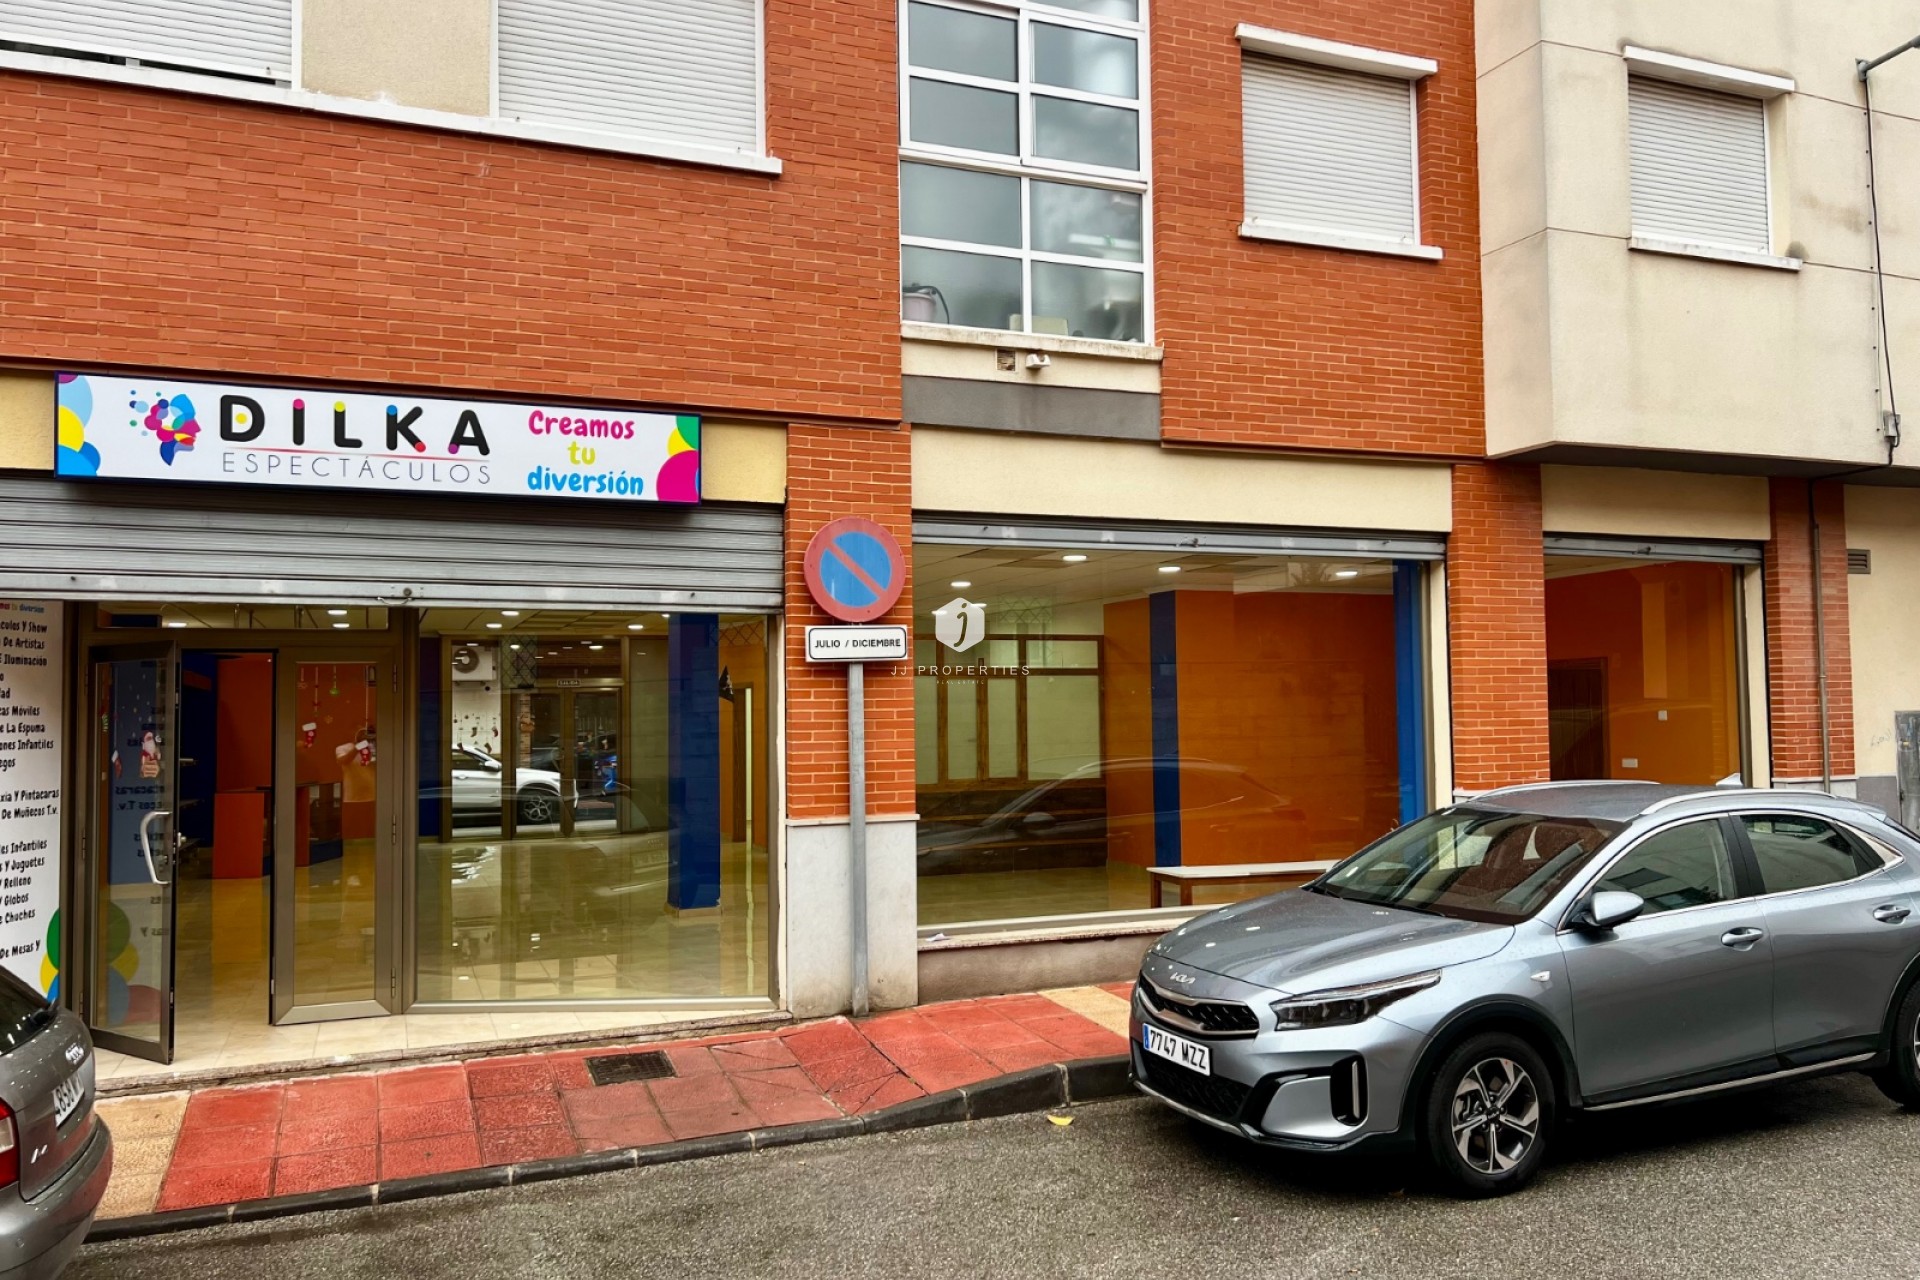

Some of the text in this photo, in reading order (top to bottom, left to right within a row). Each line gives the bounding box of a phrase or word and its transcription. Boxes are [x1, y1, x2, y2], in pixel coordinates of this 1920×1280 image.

[220, 394, 490, 456] DILKA
[528, 410, 635, 439] Creamos
[567, 441, 596, 465] tu
[222, 452, 491, 485] ESPECTÁCULOS
[527, 465, 644, 495] diversión
[0, 620, 48, 633] culos Y Show
[3, 636, 45, 649] De Artistas
[815, 638, 901, 648] JULIO / DICIEMBRE
[4, 653, 48, 666] Iluminación
[12, 705, 40, 717] Móviles
[7, 722, 16, 733] La
[18, 722, 45, 735] Espuma
[18, 739, 54, 751] Infantiles
[14, 789, 19, 802] Y
[21, 789, 60, 801] Pintacaras
[2, 808, 12, 820] De
[14, 806, 45, 818] Muñecos
[11, 839, 48, 854] Infantiles
[5, 860, 10, 872] Y
[11, 856, 45, 873] Juguetes
[4, 876, 32, 889] Relleno
[4, 892, 29, 906] Globos
[5, 909, 36, 924] Chuches
[11, 943, 35, 957] Mesas
[35, 939, 41, 952] Y
[1150, 1029, 1207, 1071] 7747 MZZ
